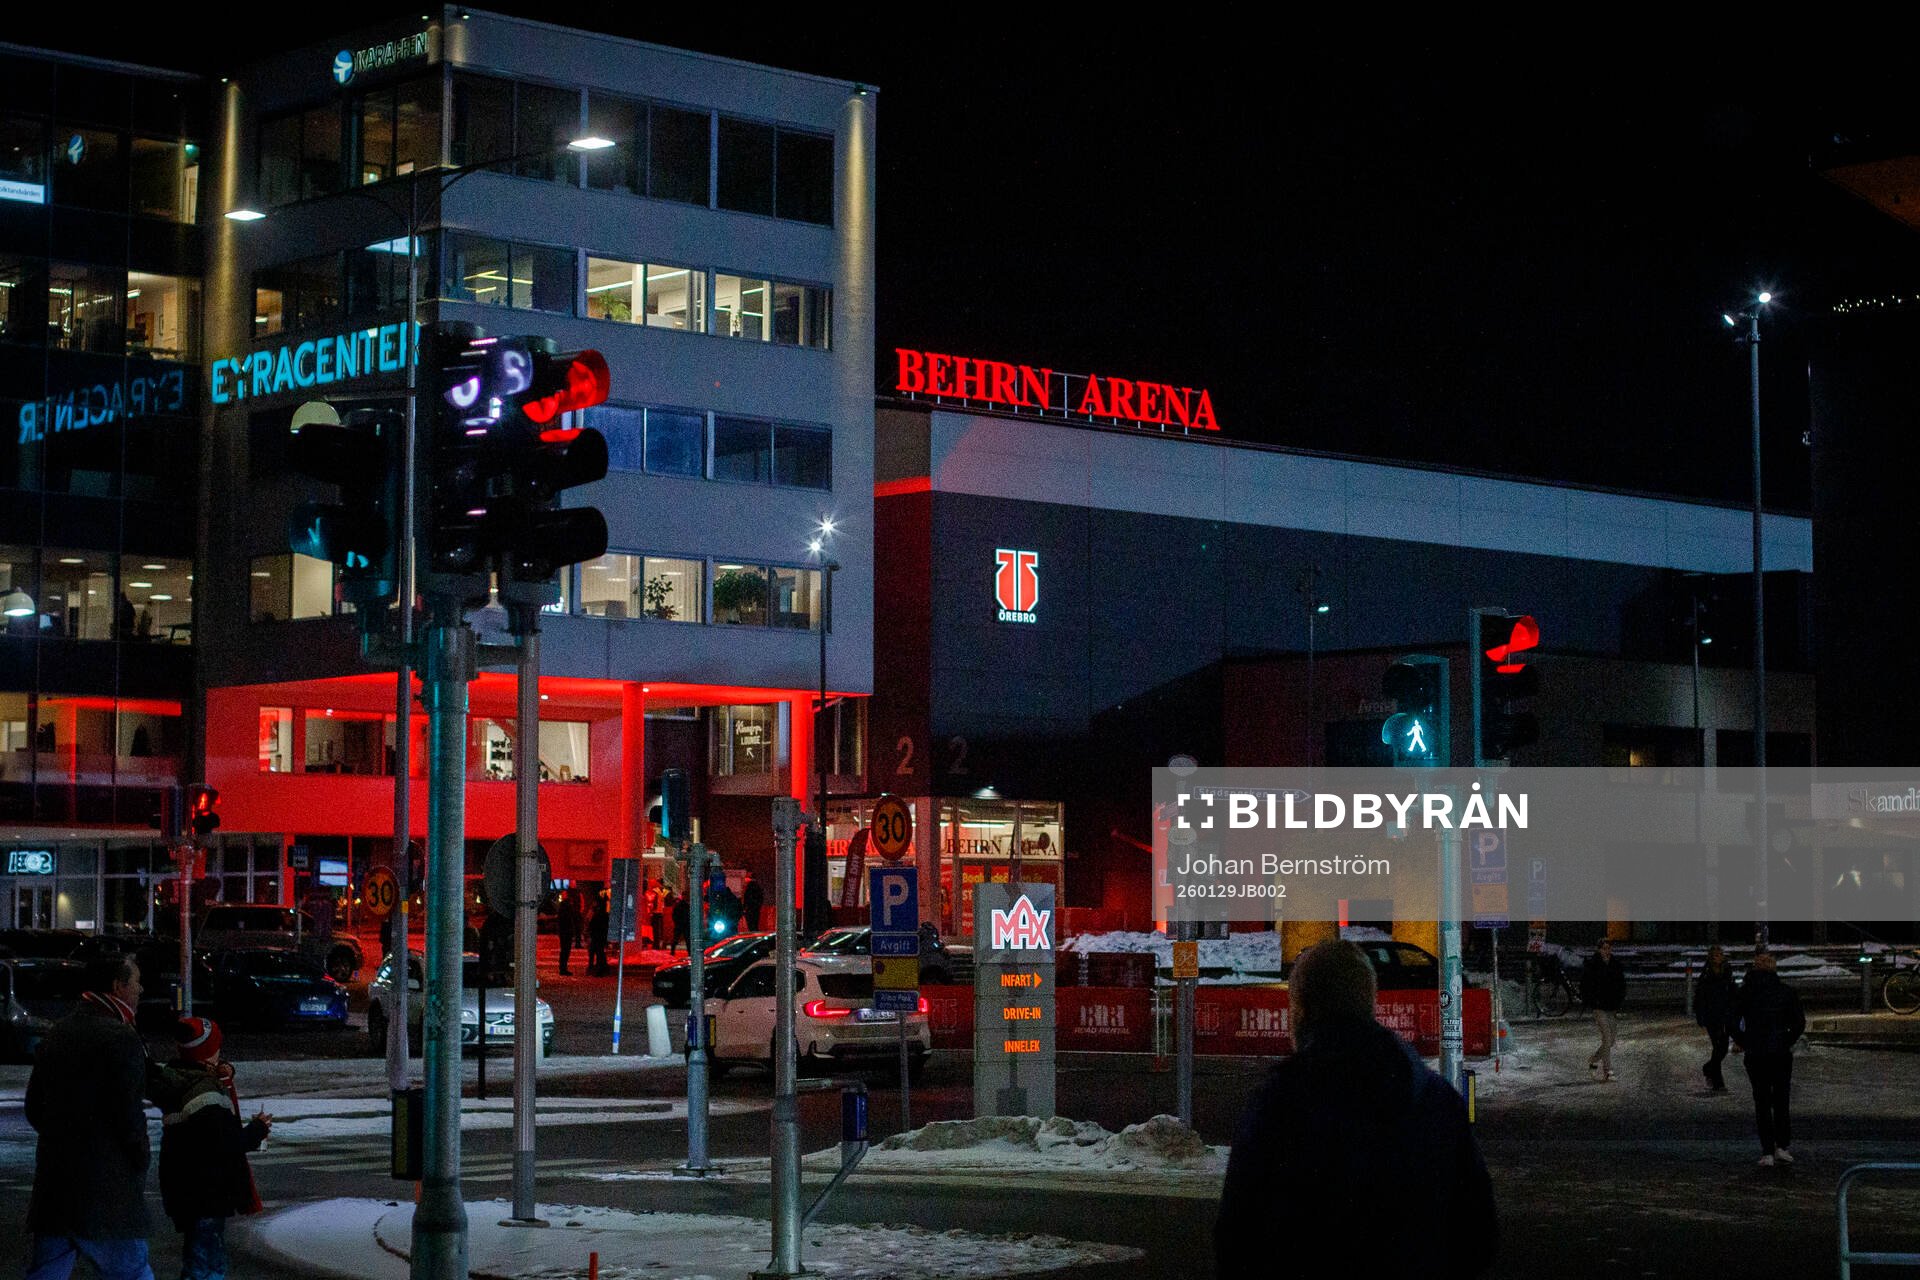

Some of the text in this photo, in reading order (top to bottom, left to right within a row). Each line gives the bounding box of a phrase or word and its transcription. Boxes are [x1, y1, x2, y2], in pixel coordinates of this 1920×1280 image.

[896, 348, 1221, 431] BEHRN ARENA
[998, 608, 1037, 624] ÖREBRO
[896, 735, 914, 775] 2
[878, 811, 905, 845] 30
[946, 838, 1002, 855] BEHRN
[1478, 832, 1499, 866] P
[368, 880, 394, 908] 30
[882, 874, 909, 927] P
[991, 893, 1051, 950] MAX
[880, 939, 911, 953] Avgift
[1001, 973, 1032, 988] INFART
[1003, 1007, 1042, 1021] DRIVE-IN
[1003, 1039, 1041, 1053] INNELEK
